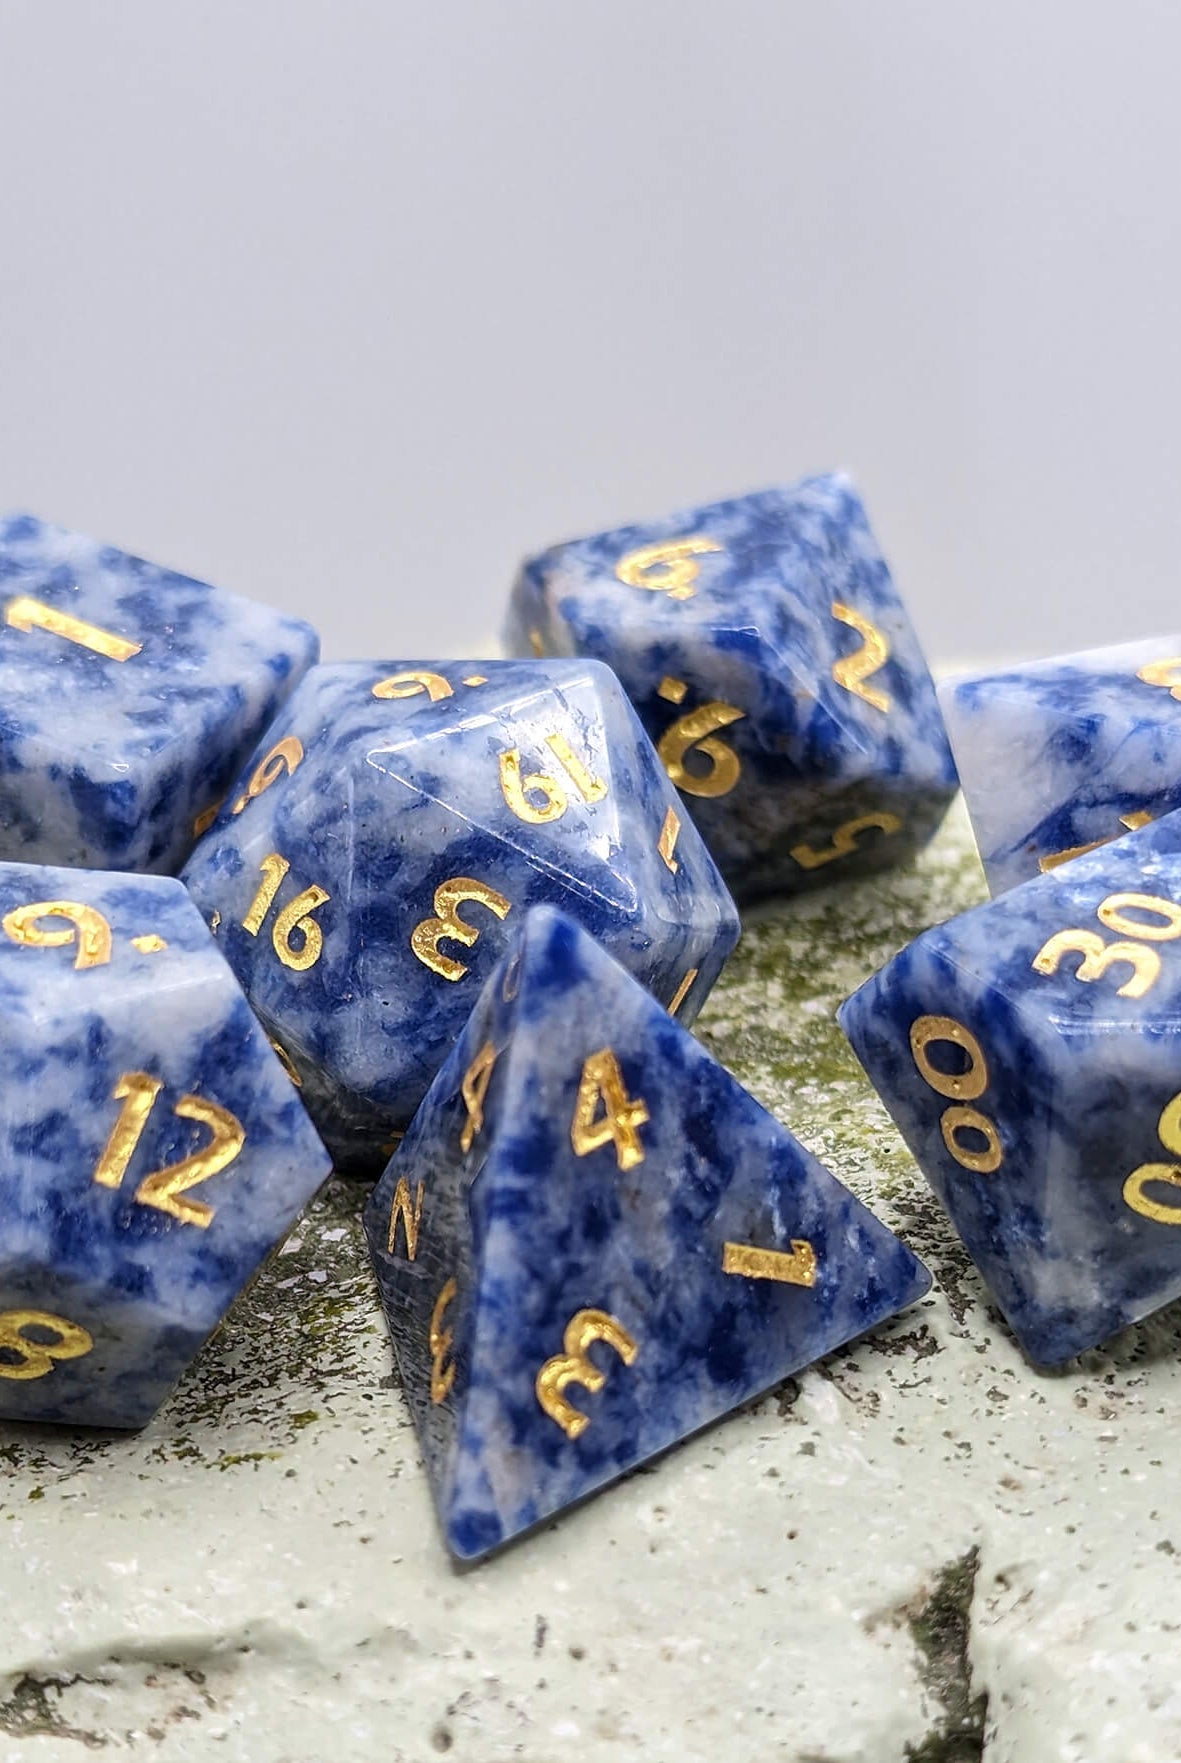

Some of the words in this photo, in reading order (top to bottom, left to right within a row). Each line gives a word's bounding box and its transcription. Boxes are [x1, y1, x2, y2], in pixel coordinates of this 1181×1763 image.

[7, 597, 142, 662] 1
[830, 602, 889, 712] 2
[242, 853, 331, 971] 16
[411, 876, 512, 982] 3
[1032, 892, 1181, 999] 30
[94, 1071, 246, 1228] 12
[571, 1047, 650, 1171] 4
[722, 1239, 817, 1288] 1
[536, 1308, 638, 1440] 3
